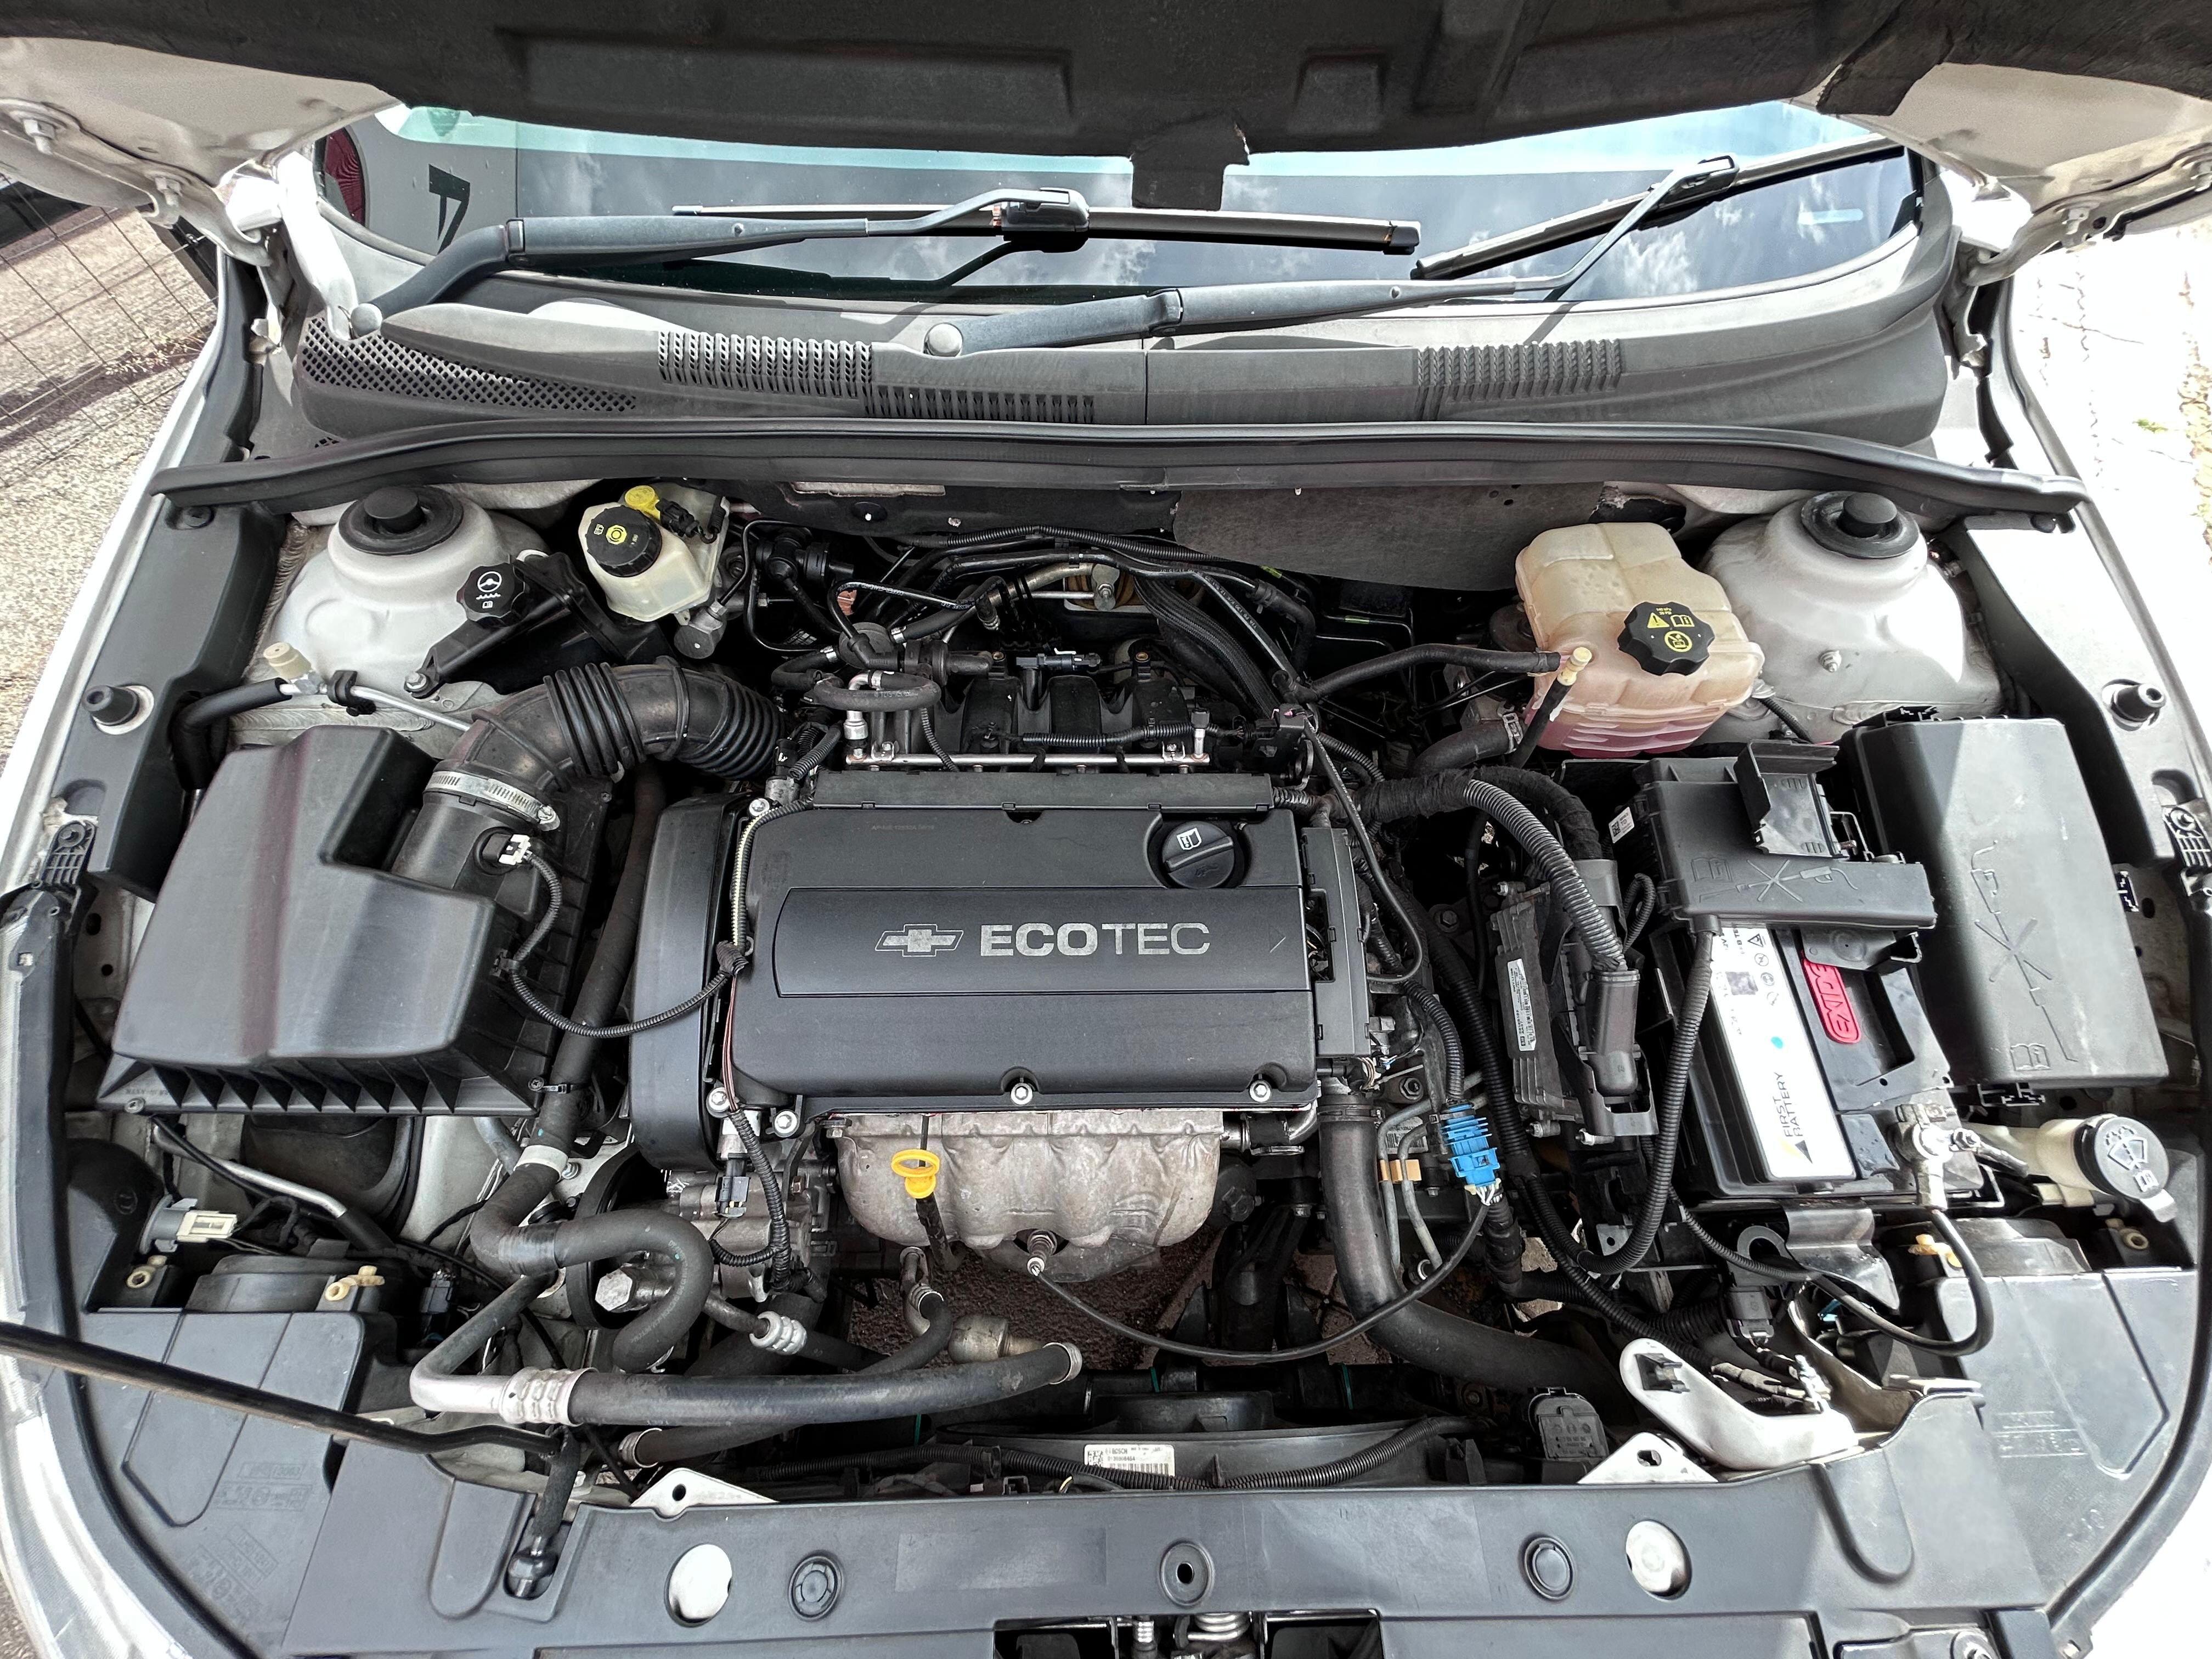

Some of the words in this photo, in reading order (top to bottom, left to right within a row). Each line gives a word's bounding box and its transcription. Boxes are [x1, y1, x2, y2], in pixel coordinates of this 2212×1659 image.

[980, 923, 1210, 956] ECOTEC
[1810, 963, 1859, 1040] EXIDE
[1773, 1071, 1804, 1137] BATTERY
[1773, 1096, 1795, 1137] FIRST
